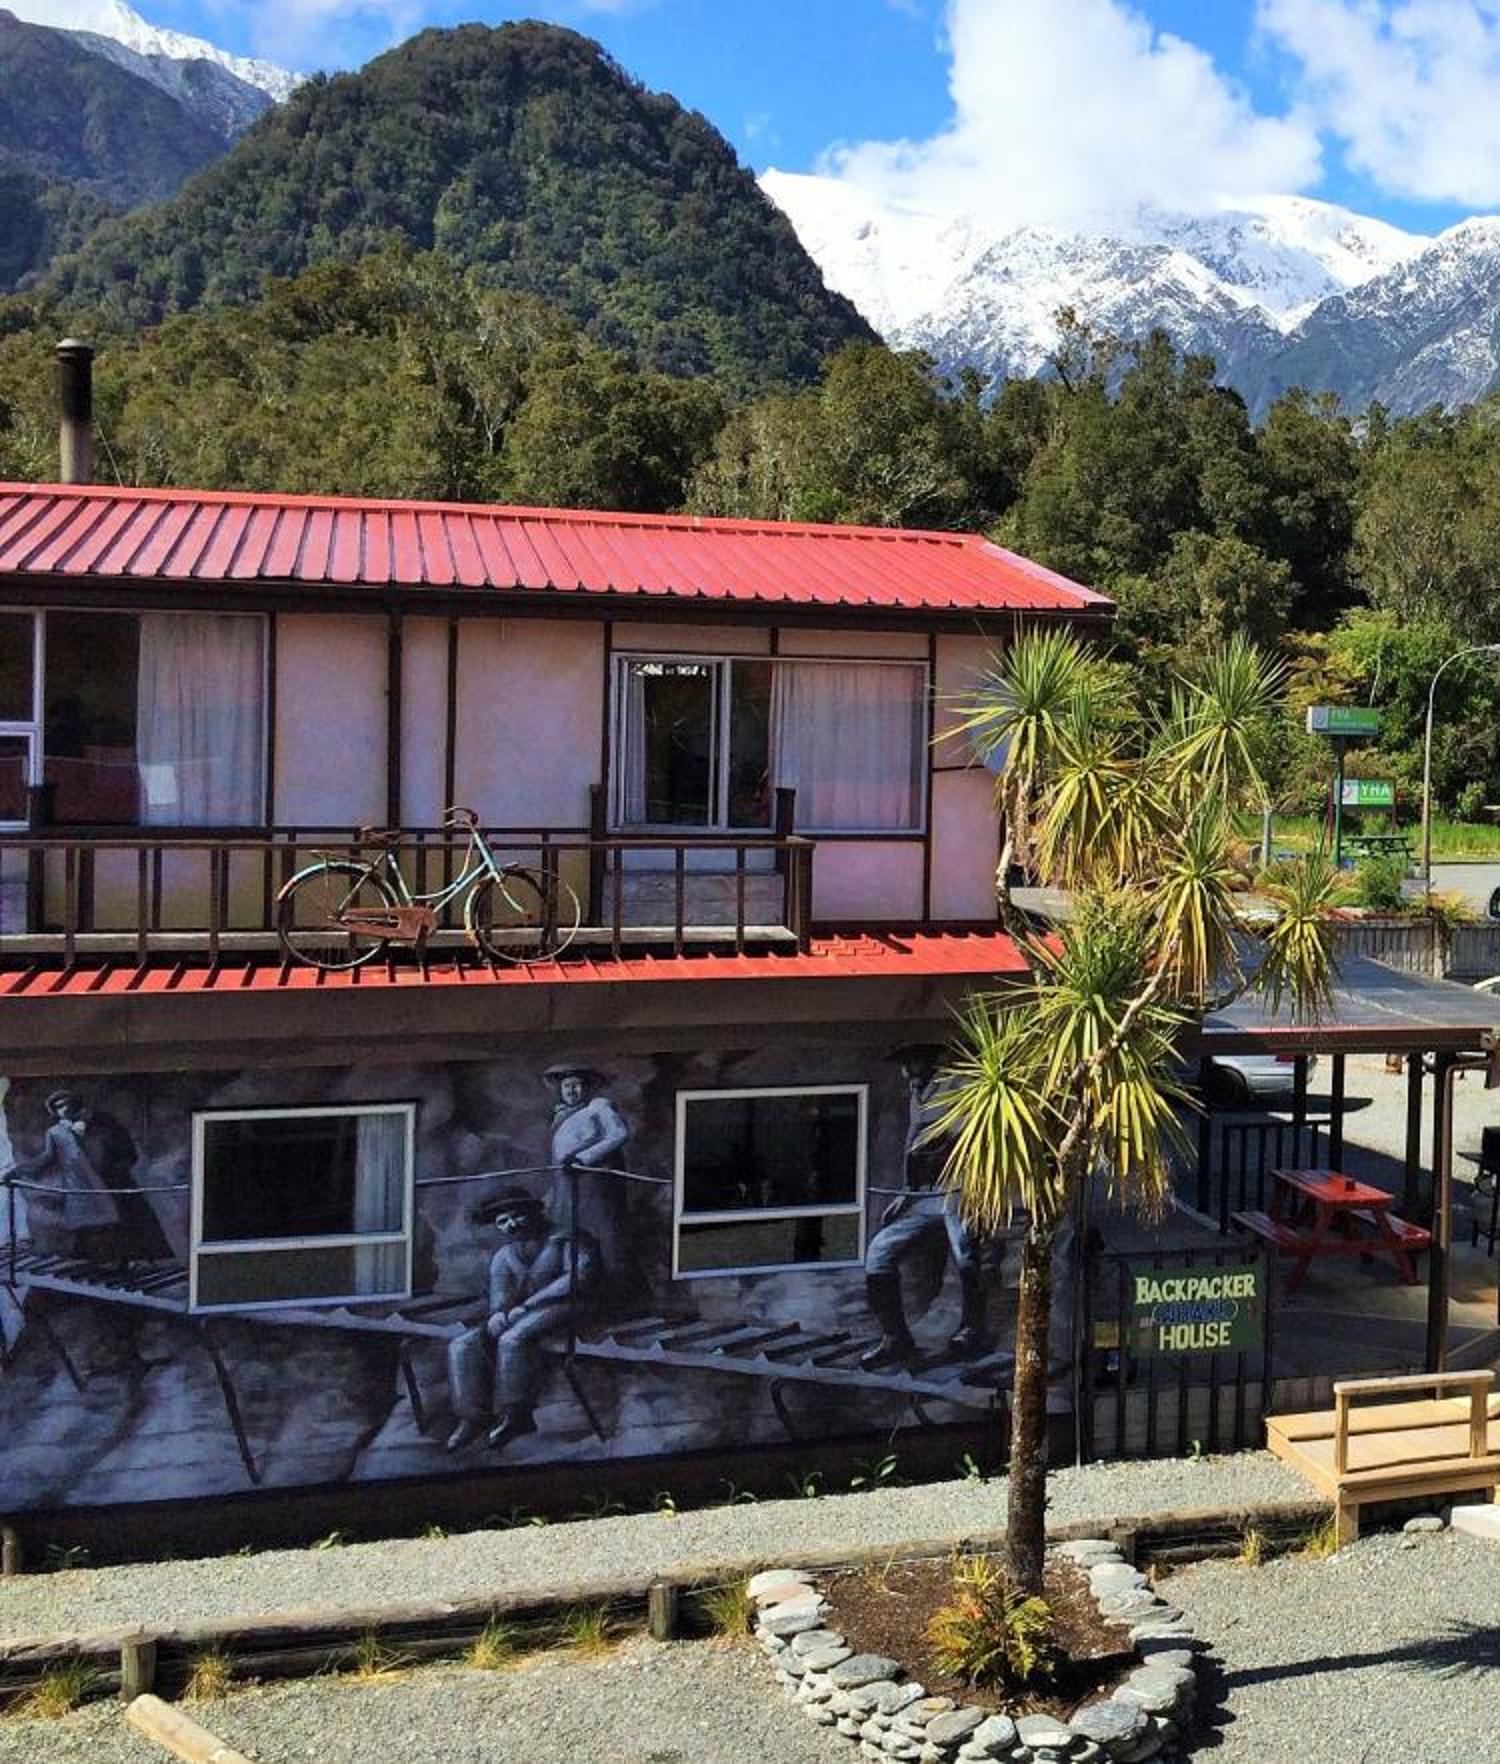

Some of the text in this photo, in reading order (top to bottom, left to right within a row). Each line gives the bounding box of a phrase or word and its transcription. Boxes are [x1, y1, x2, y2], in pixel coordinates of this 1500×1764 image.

[1361, 783, 1391, 797] YHA
[1135, 1273, 1256, 1304] BACKPACKER
[1159, 1321, 1232, 1351] HOUSE
